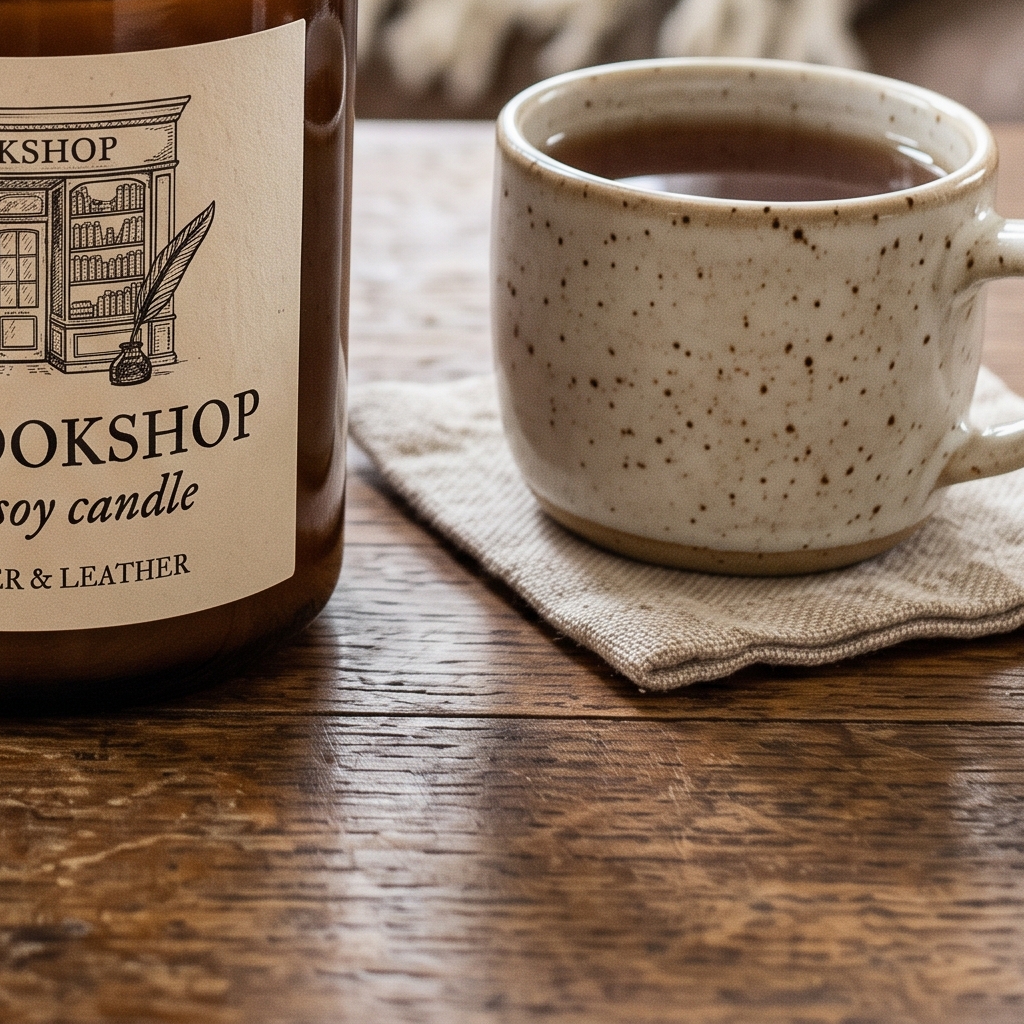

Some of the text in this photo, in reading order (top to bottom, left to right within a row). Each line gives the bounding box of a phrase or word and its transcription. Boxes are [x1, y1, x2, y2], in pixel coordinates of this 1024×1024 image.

[67, 469, 199, 525] candle
[29, 567, 53, 590] &
[59, 553, 191, 590] LEATHER
